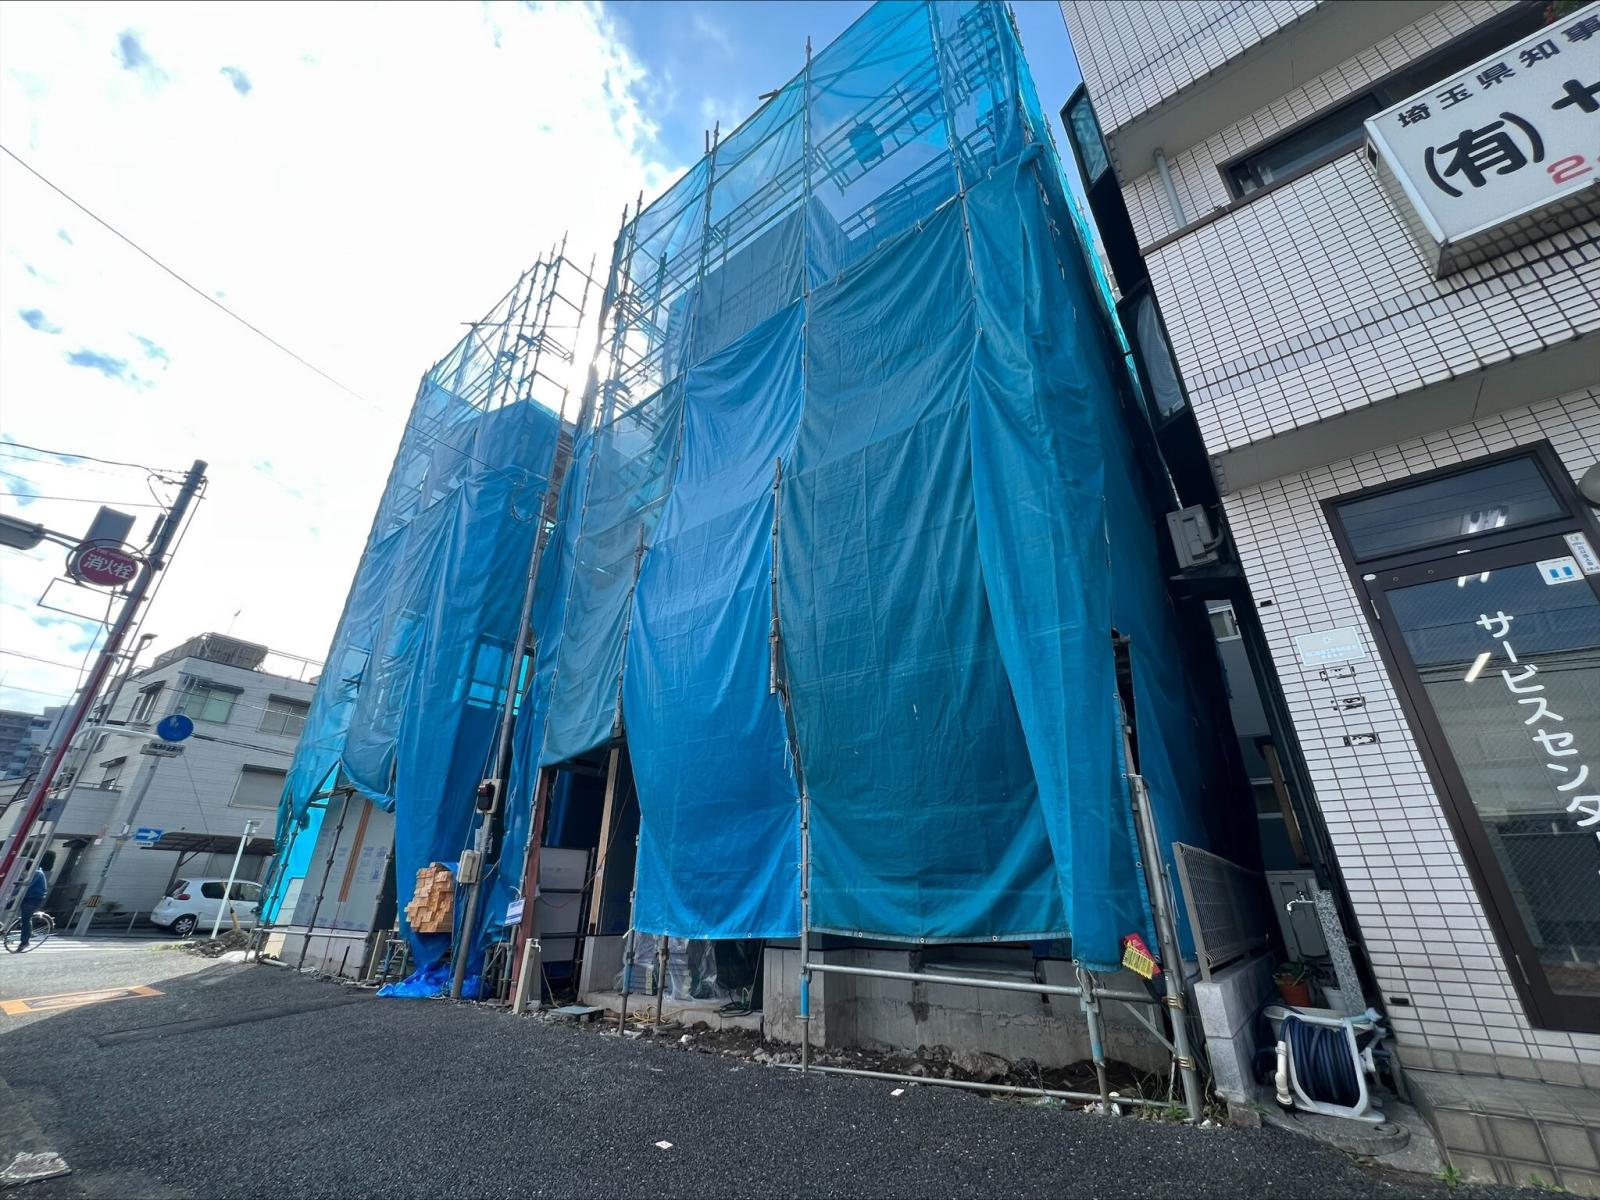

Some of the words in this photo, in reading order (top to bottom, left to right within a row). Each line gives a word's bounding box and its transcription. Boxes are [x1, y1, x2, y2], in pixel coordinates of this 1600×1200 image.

[1398, 15, 1600, 128] 埼玉県知事
[83, 553, 133, 580] 消火栓
[1476, 611, 1600, 843] サービスセンタ
